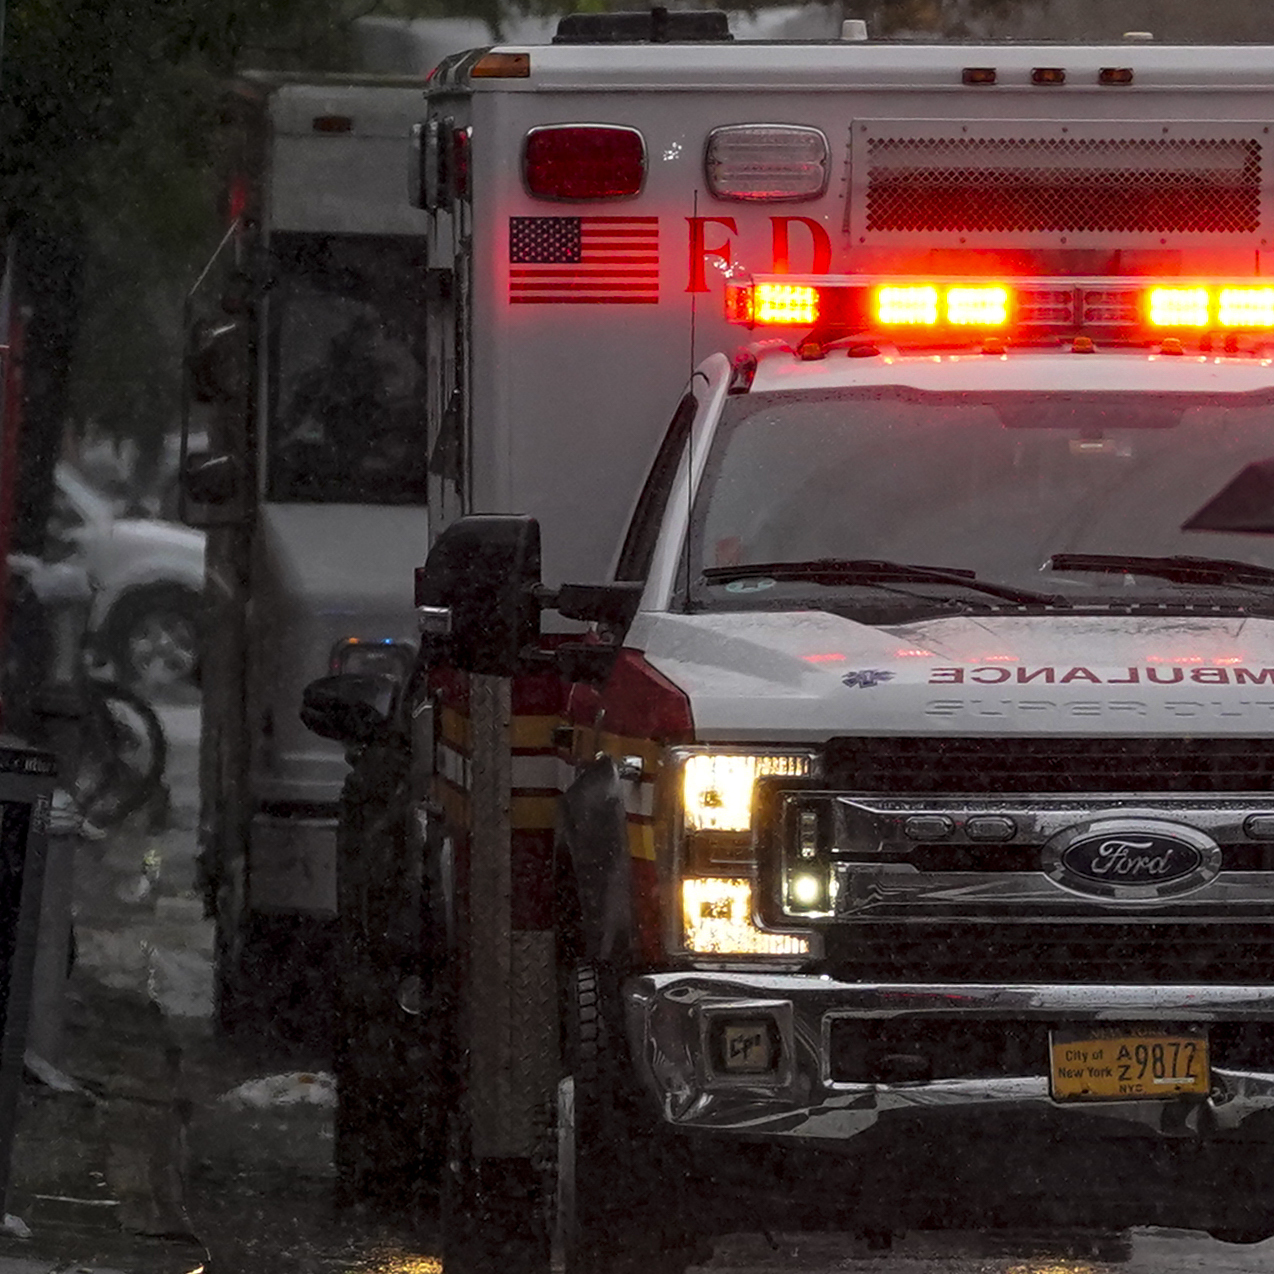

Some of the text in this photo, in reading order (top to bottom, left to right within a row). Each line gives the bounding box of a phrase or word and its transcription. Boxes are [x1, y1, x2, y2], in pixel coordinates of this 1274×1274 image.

[1091, 840, 1173, 875] Ford
[1065, 1050, 1103, 1063] City of
[1134, 1042, 1198, 1080] 9872
[1058, 1067, 1113, 1079] New York
[1118, 1084, 1144, 1093] NYC
